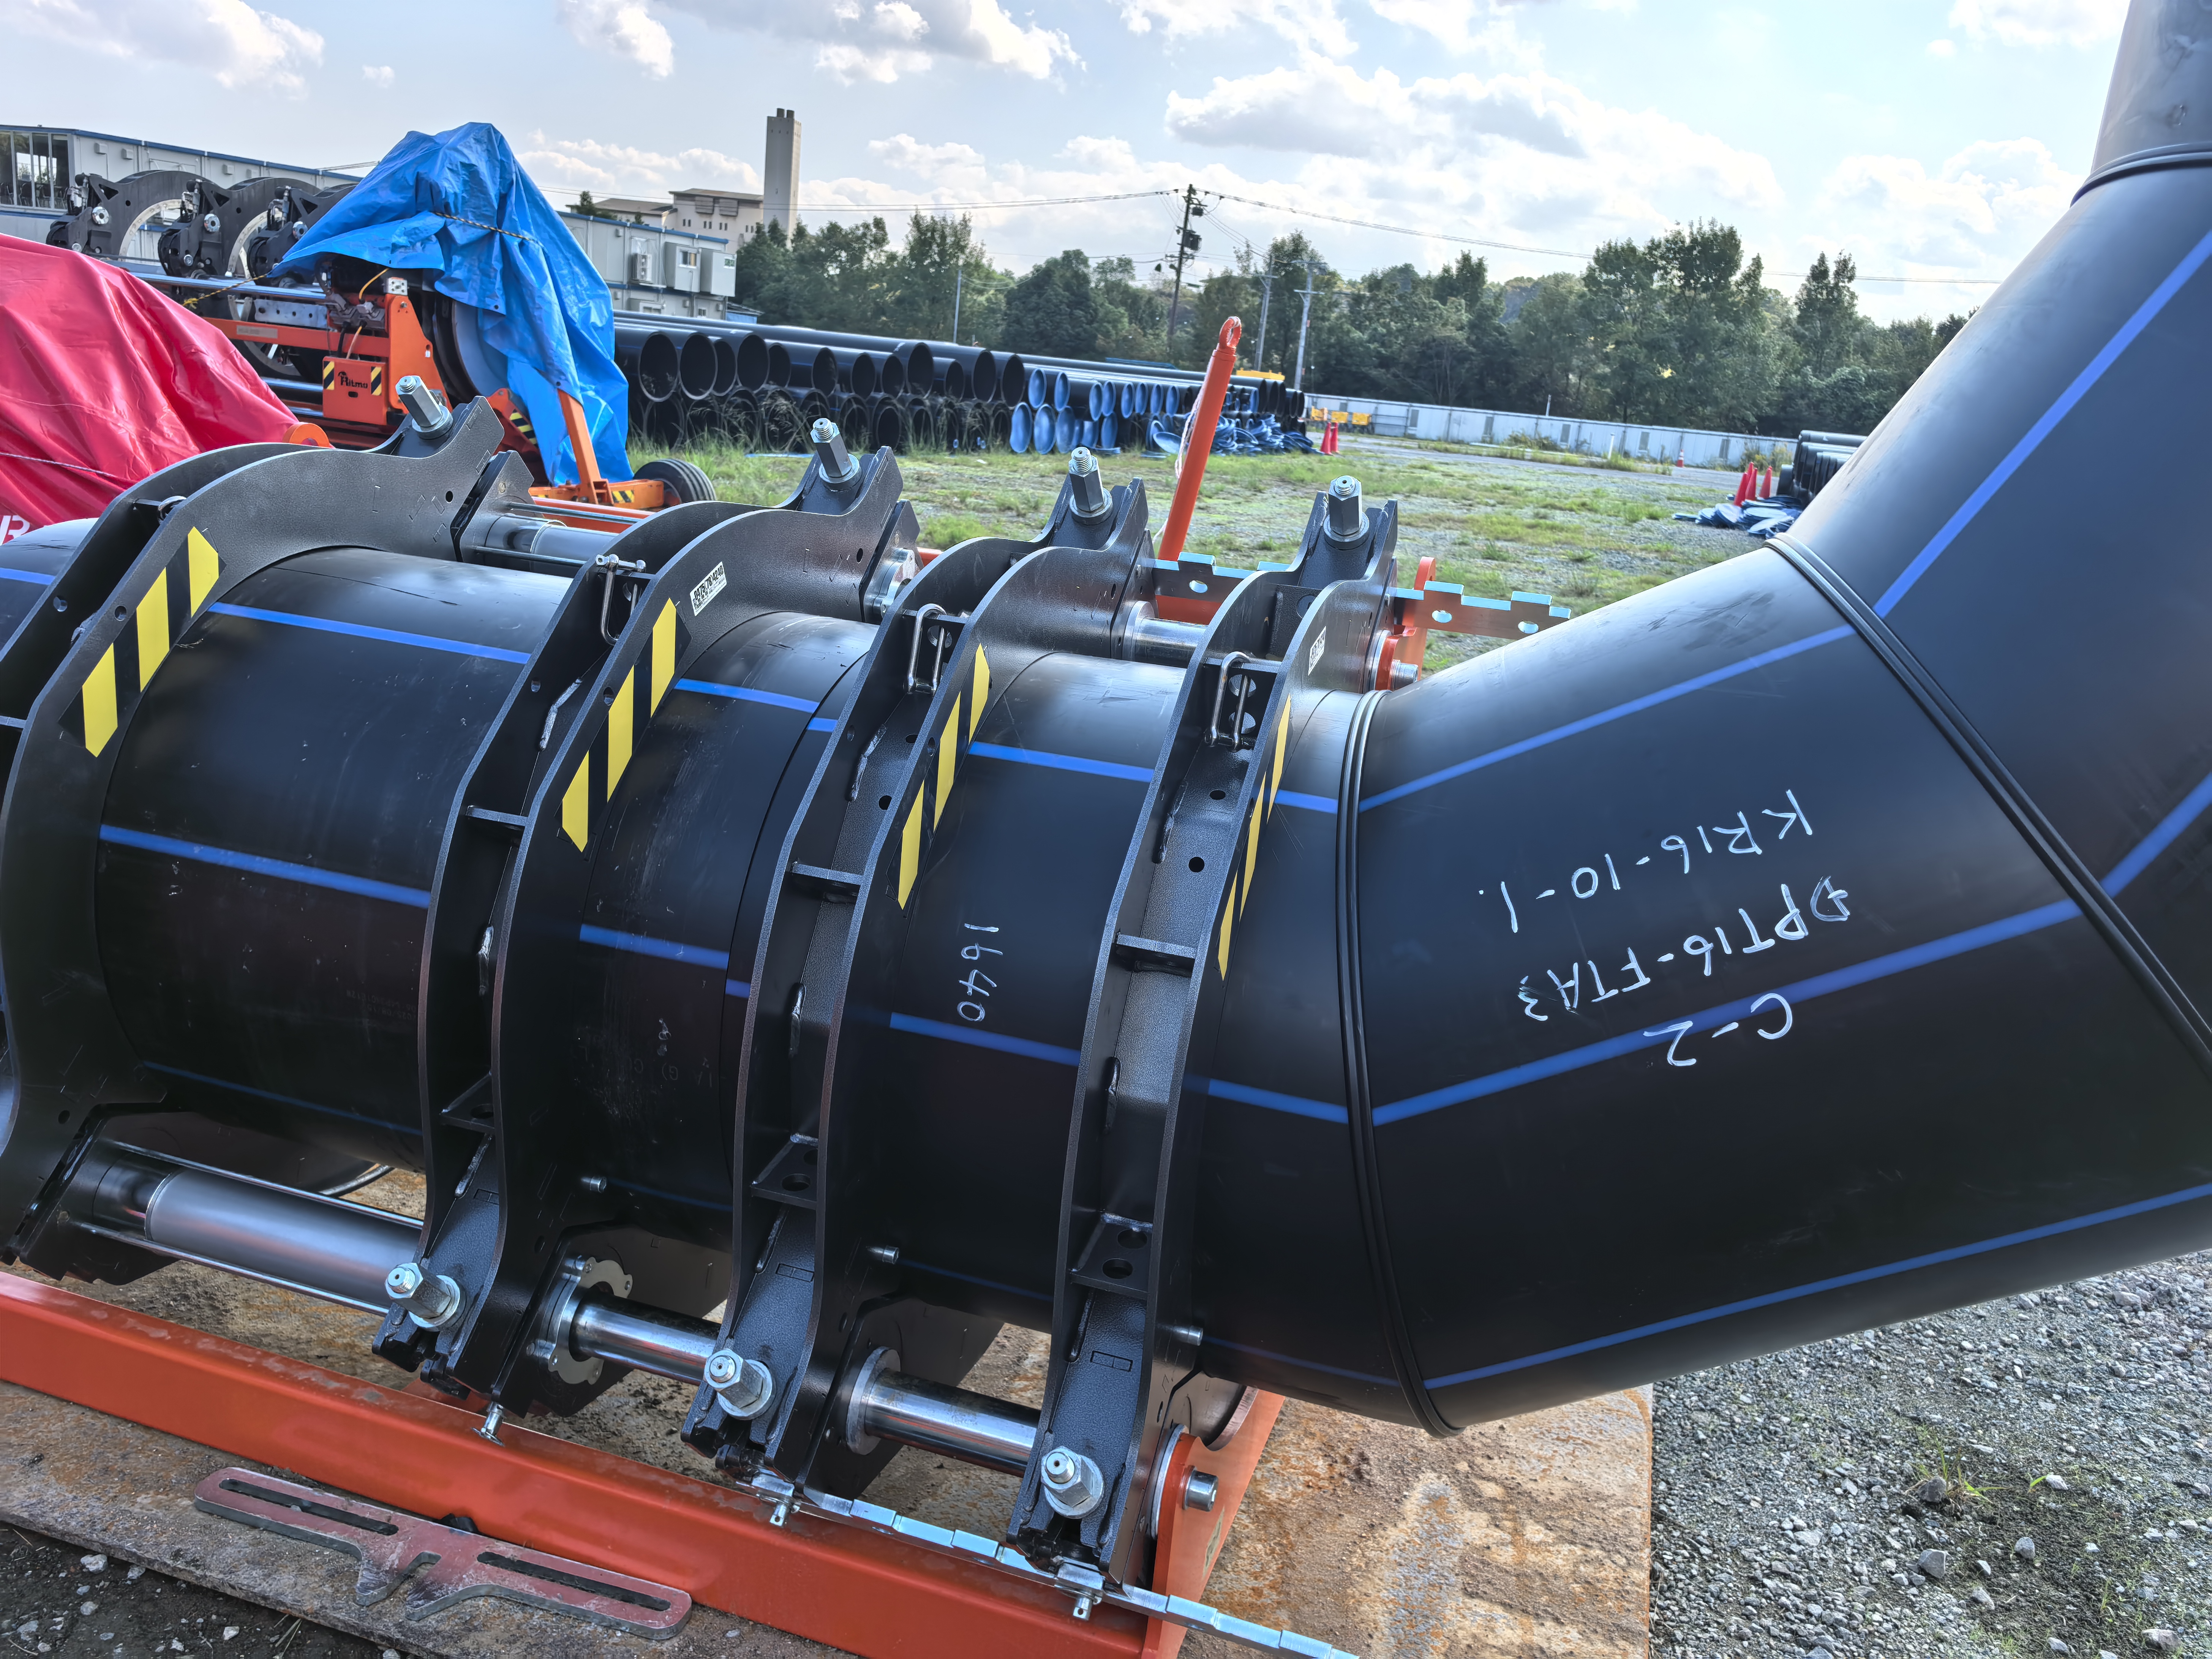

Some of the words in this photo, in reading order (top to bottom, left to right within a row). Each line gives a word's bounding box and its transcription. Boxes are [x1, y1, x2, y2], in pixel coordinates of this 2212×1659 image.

[338, 371, 368, 389] Ritmo
[956, 923, 1003, 1022] 1640
[1517, 875, 1850, 1022] DPT16-FTA3
[1642, 993, 1793, 1066] C-2
